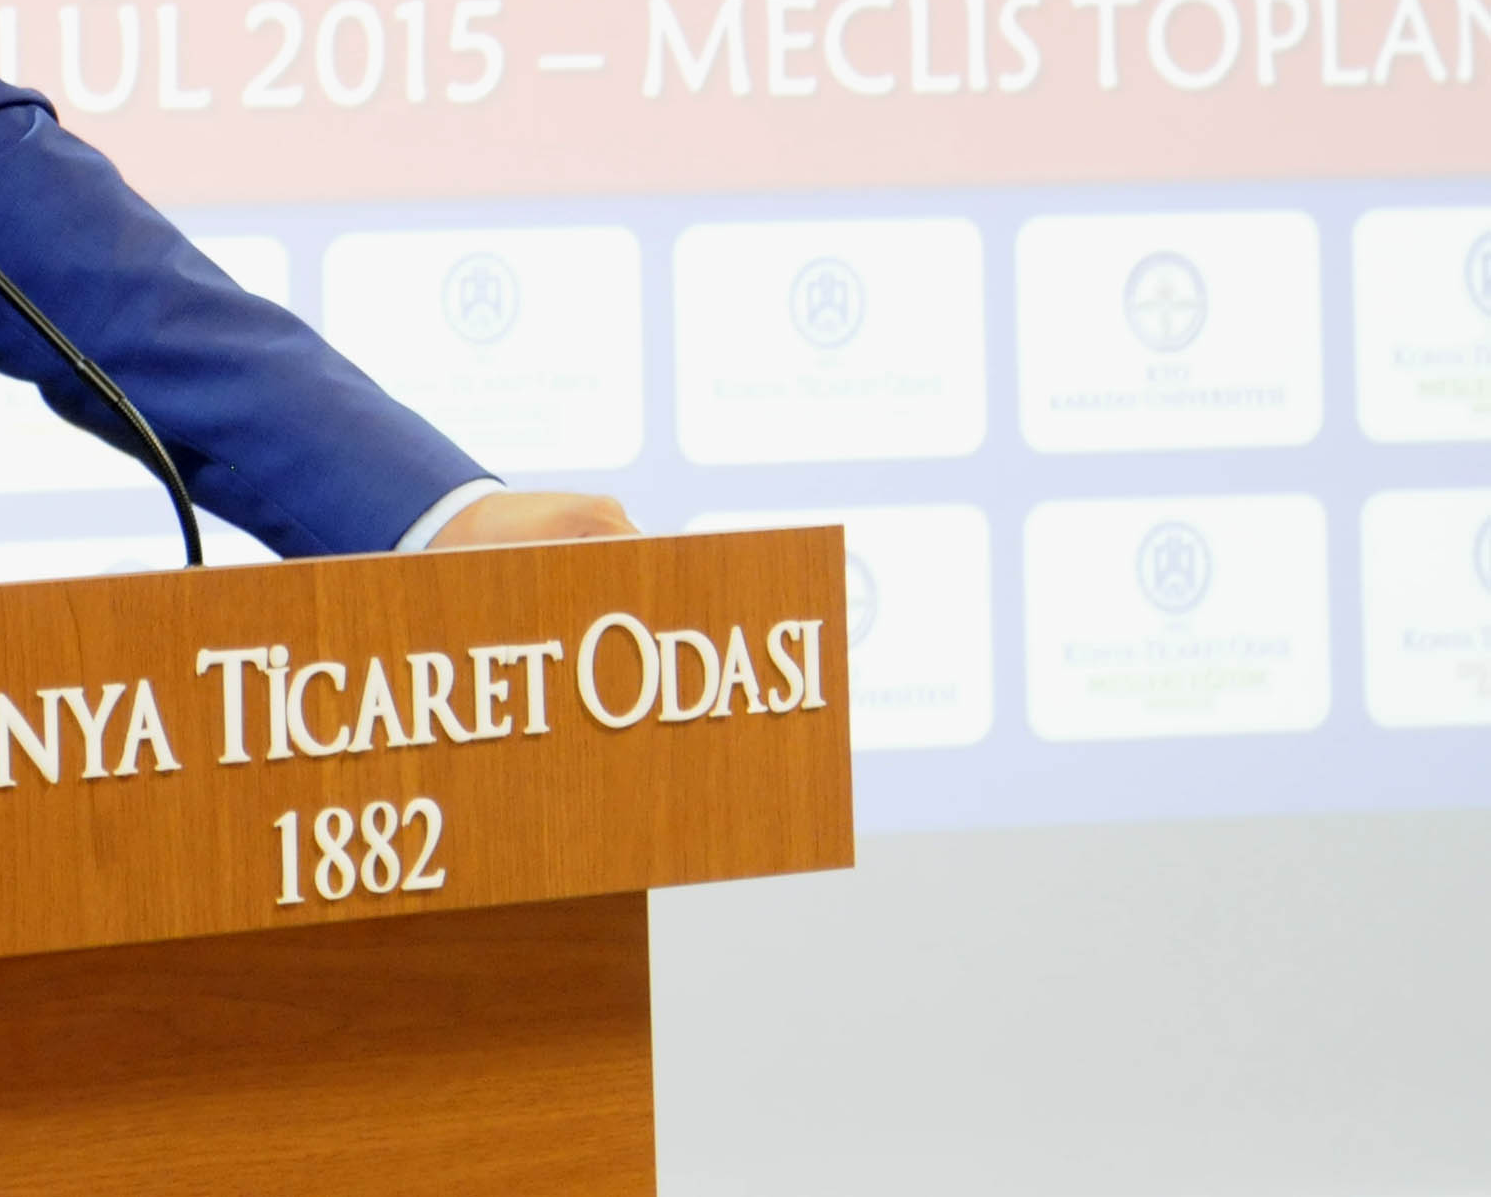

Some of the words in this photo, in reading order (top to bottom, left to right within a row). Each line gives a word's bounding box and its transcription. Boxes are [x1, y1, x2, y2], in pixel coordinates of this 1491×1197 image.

[196, 643, 564, 765] TİCARET
[577, 612, 828, 729] ODASI
[273, 797, 446, 904] 1882
